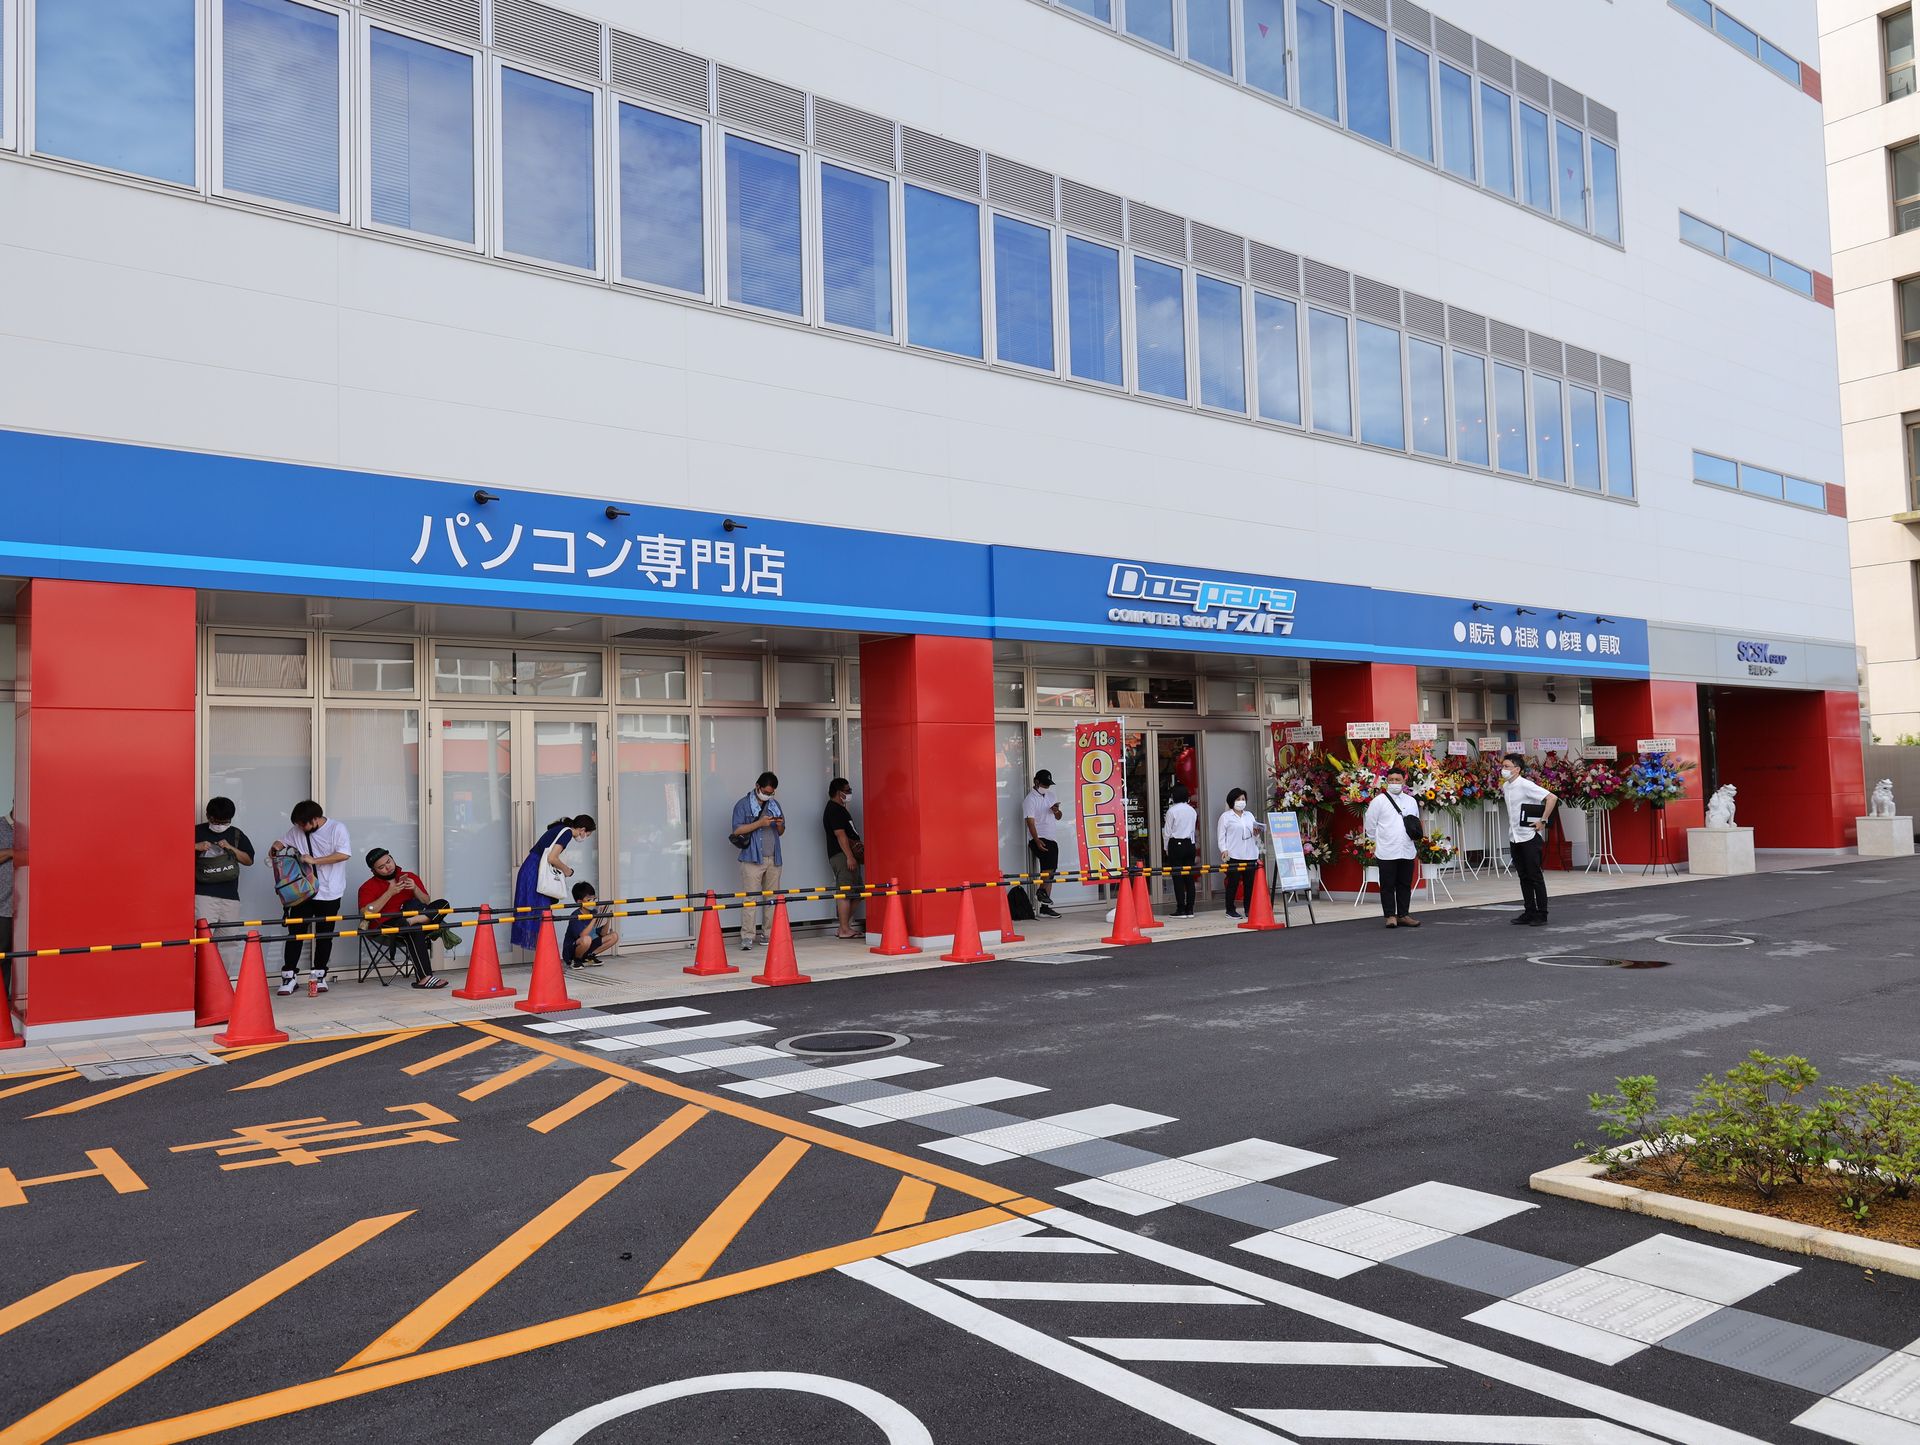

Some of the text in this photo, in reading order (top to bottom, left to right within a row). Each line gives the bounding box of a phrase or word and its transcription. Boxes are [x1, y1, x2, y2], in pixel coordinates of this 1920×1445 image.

[410, 512, 786, 597] パソコン専門店
[1107, 563, 1297, 613] Dospara
[1108, 608, 1295, 635] COMPUTER SHOP ドスパラ
[1469, 622, 1621, 655] 販売 相談 修理 買取
[1737, 640, 1770, 663] SCSK
[1081, 750, 1122, 879] OPEN
